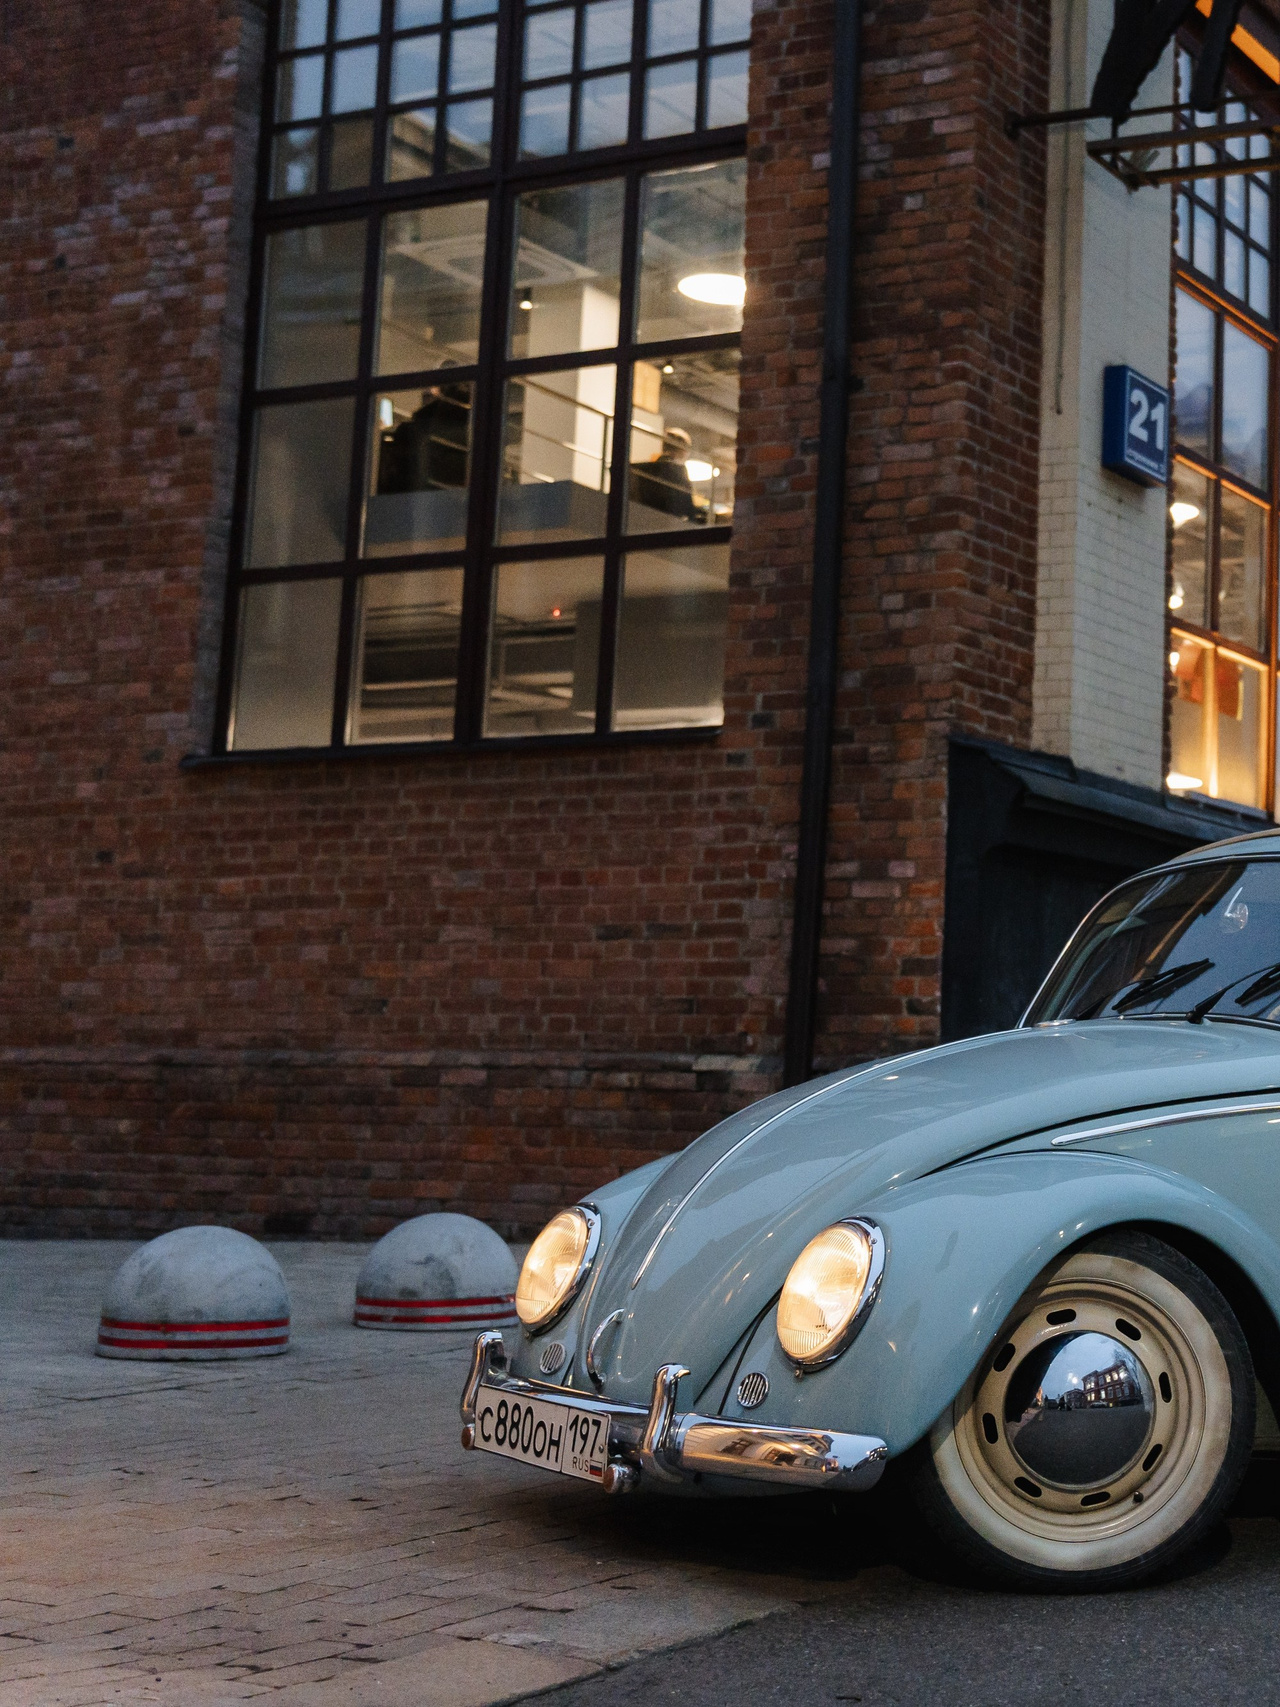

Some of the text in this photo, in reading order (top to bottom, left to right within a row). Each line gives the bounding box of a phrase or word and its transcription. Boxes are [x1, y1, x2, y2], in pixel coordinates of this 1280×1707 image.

[1129, 389, 1164, 451] 21
[569, 1414, 601, 1458] 197
[572, 1456, 589, 1473] RUS
